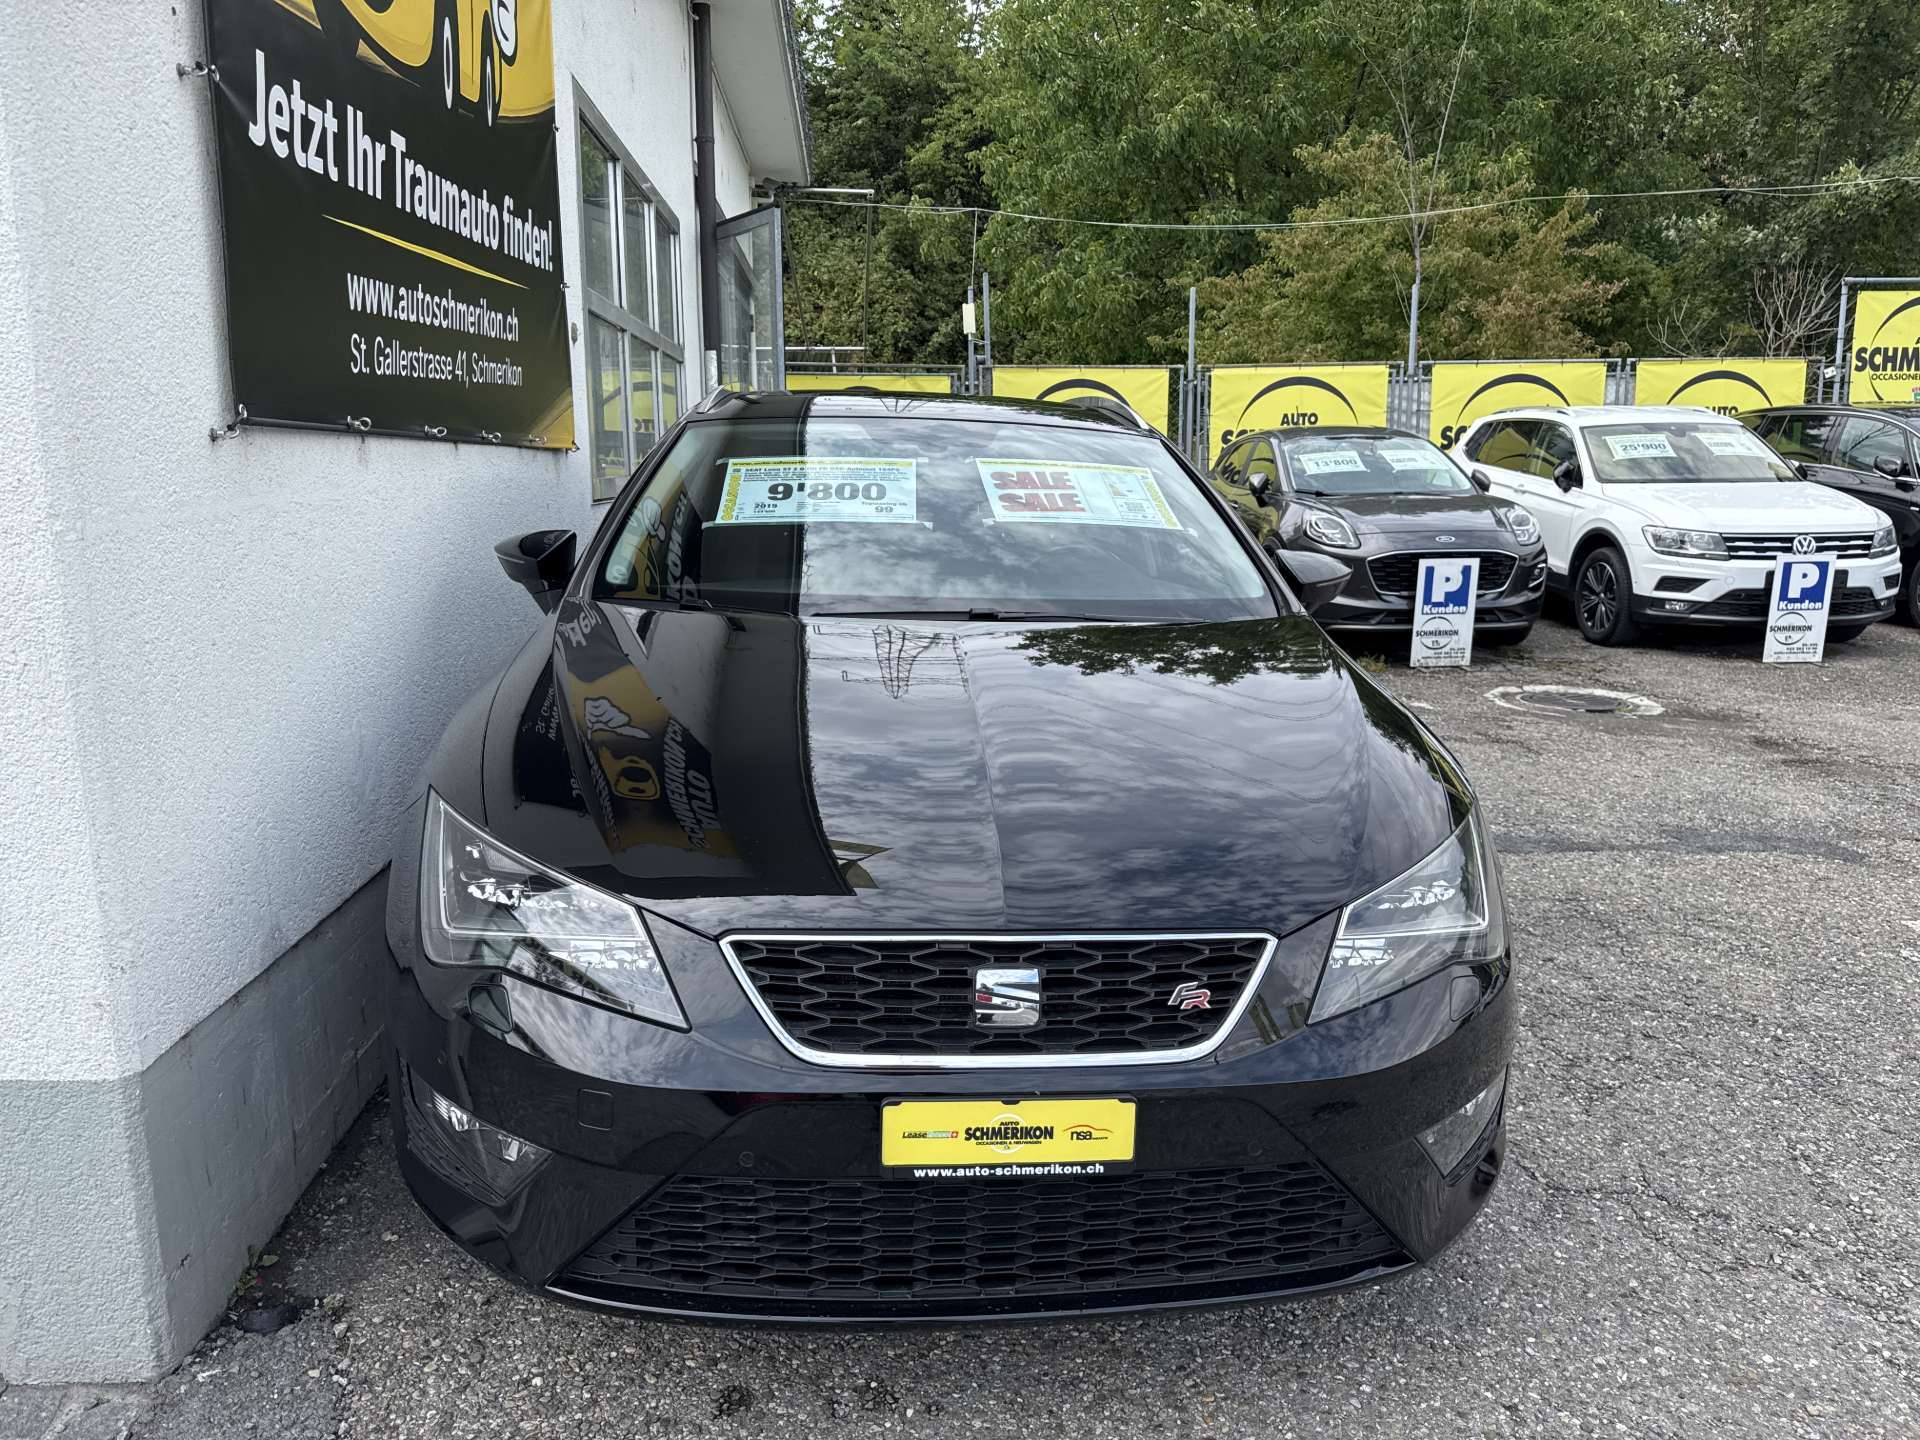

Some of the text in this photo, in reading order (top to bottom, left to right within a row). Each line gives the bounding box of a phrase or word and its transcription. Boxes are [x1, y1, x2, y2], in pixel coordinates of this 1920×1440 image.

[248, 48, 553, 273] Jetzt Ihr Traumauto finden!
[346, 272, 520, 343] www.autoschmerikon.ch
[350, 333, 523, 389] St. Gallerstrasse 41, Schmerikon
[1279, 411, 1319, 427] AUTO
[990, 471, 1076, 490] SALE
[767, 482, 887, 501] 9'800
[998, 492, 1086, 512] SALE
[1787, 562, 1820, 599] P
[1422, 603, 1467, 615] Kunden
[1778, 599, 1823, 610] Kunden
[1415, 629, 1460, 638] SCHMERIKON
[1768, 624, 1813, 633] SCHMERIKON
[1167, 981, 1212, 1010] FR
[902, 1131, 928, 1139] Lease
[964, 1126, 1054, 1141] SCHMERIKON
[1070, 1130, 1093, 1141] nsa
[913, 1163, 1105, 1178] www.auto-schmerikon.ch
